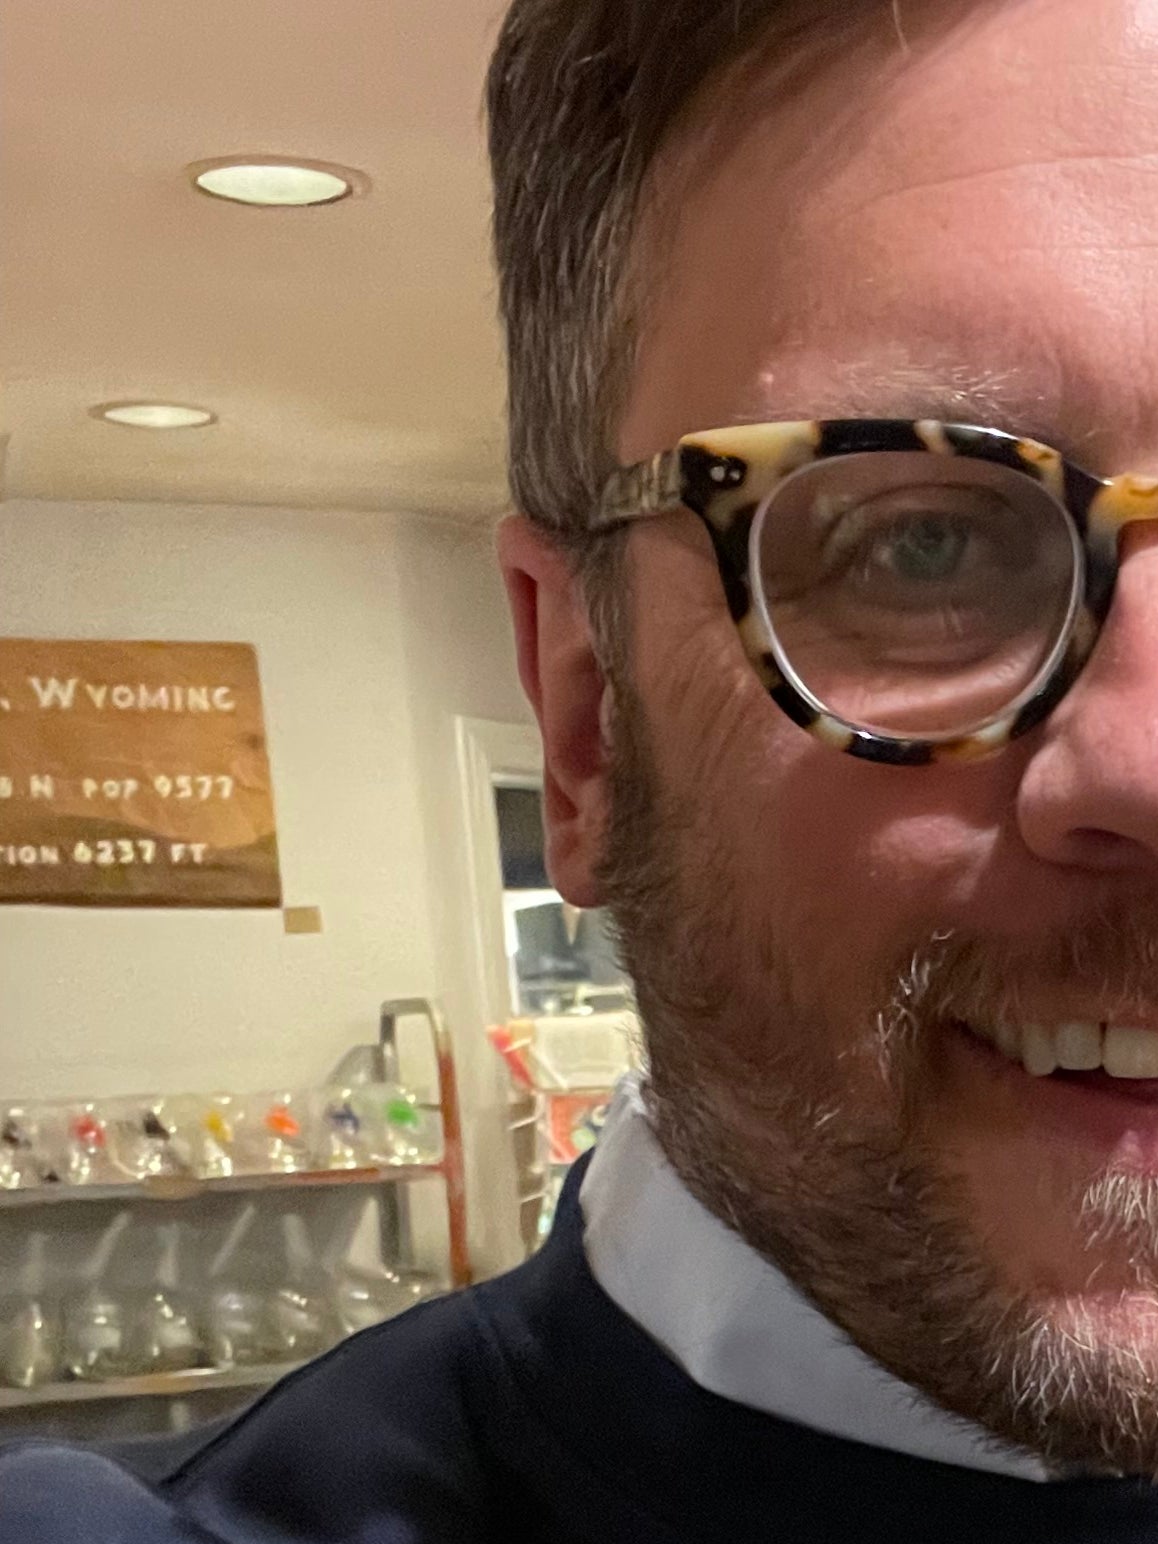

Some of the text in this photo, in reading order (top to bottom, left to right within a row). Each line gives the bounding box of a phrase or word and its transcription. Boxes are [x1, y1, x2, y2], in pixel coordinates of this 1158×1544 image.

[82, 777, 138, 799] POP
[154, 774, 234, 800] 9577
[73, 839, 156, 865] 6237
[170, 843, 207, 864] FT
